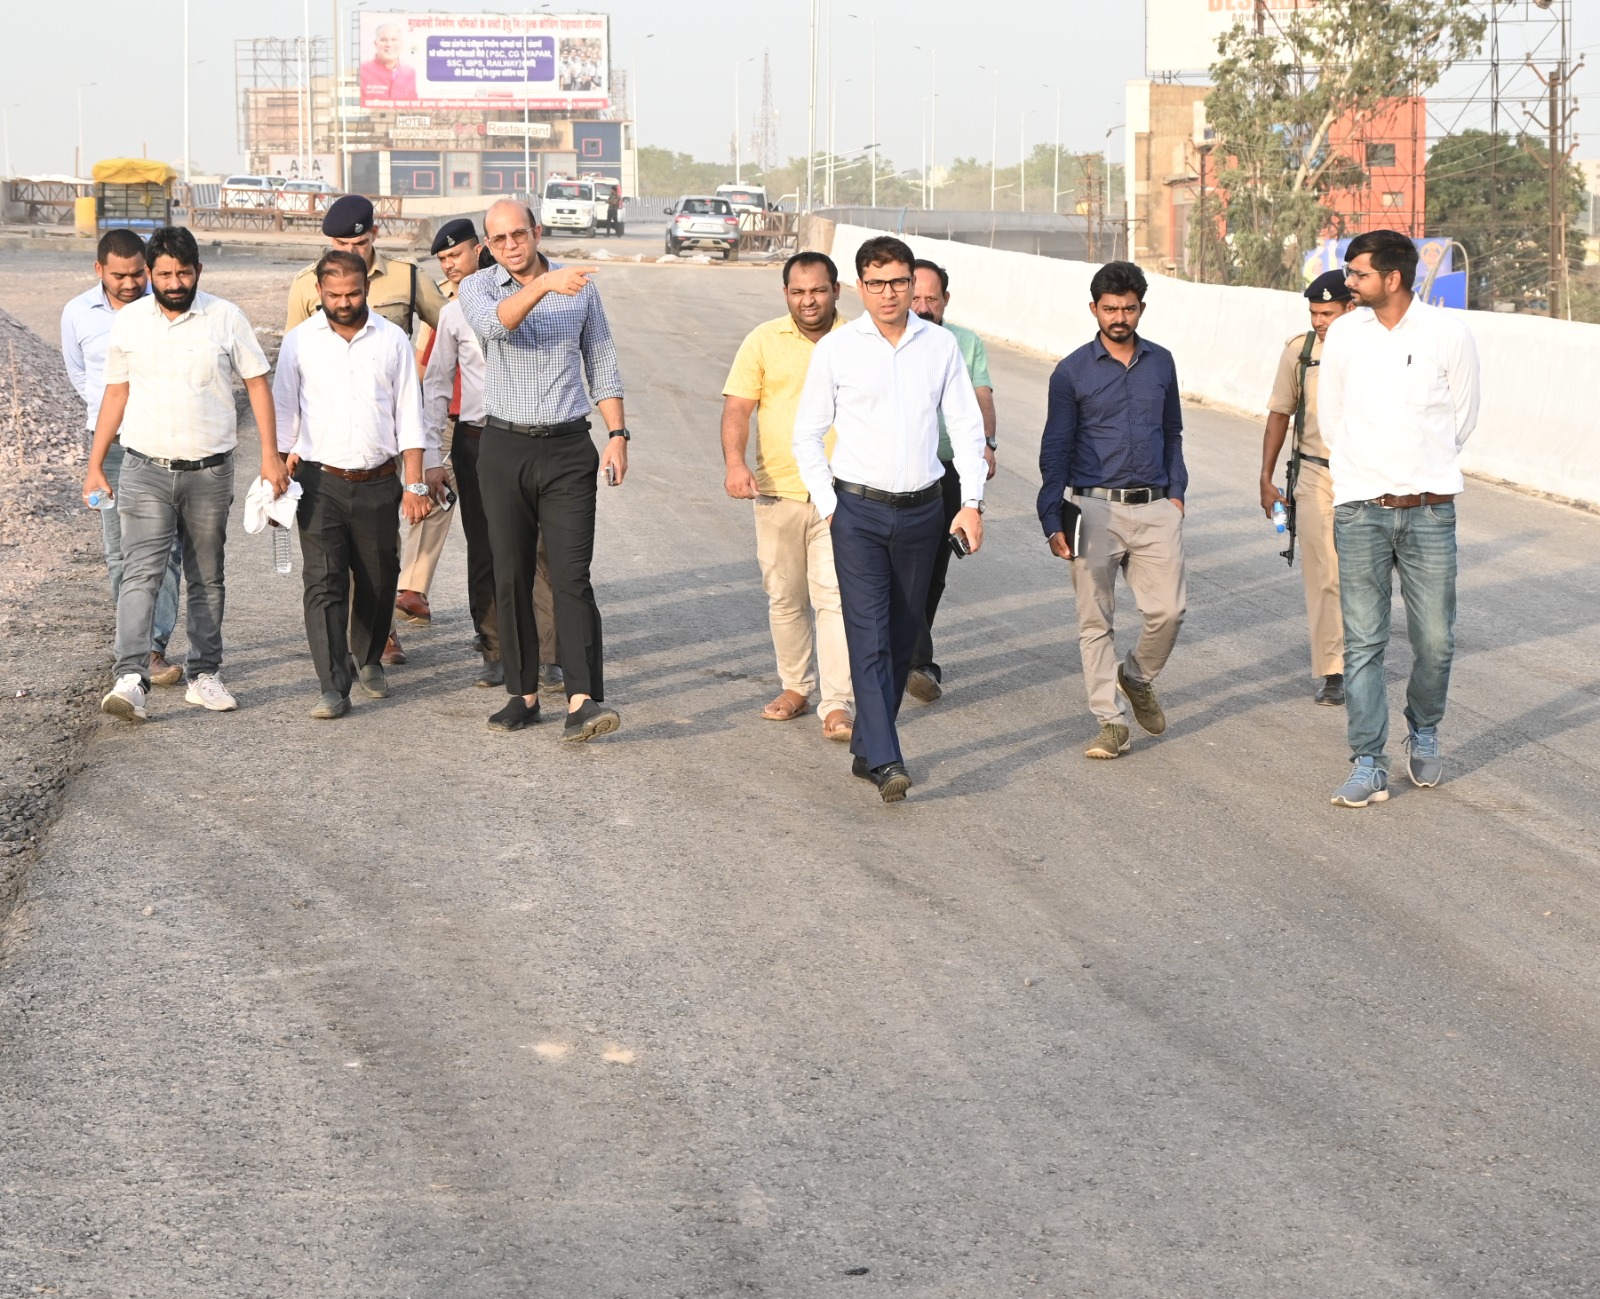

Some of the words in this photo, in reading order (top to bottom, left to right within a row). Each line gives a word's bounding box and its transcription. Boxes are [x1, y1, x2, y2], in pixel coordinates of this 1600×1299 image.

[508, 50, 520, 58] CG
[446, 59, 464, 67] SSC,
[398, 117, 429, 127] HOTEL
[488, 122, 550, 136] Restaurant
